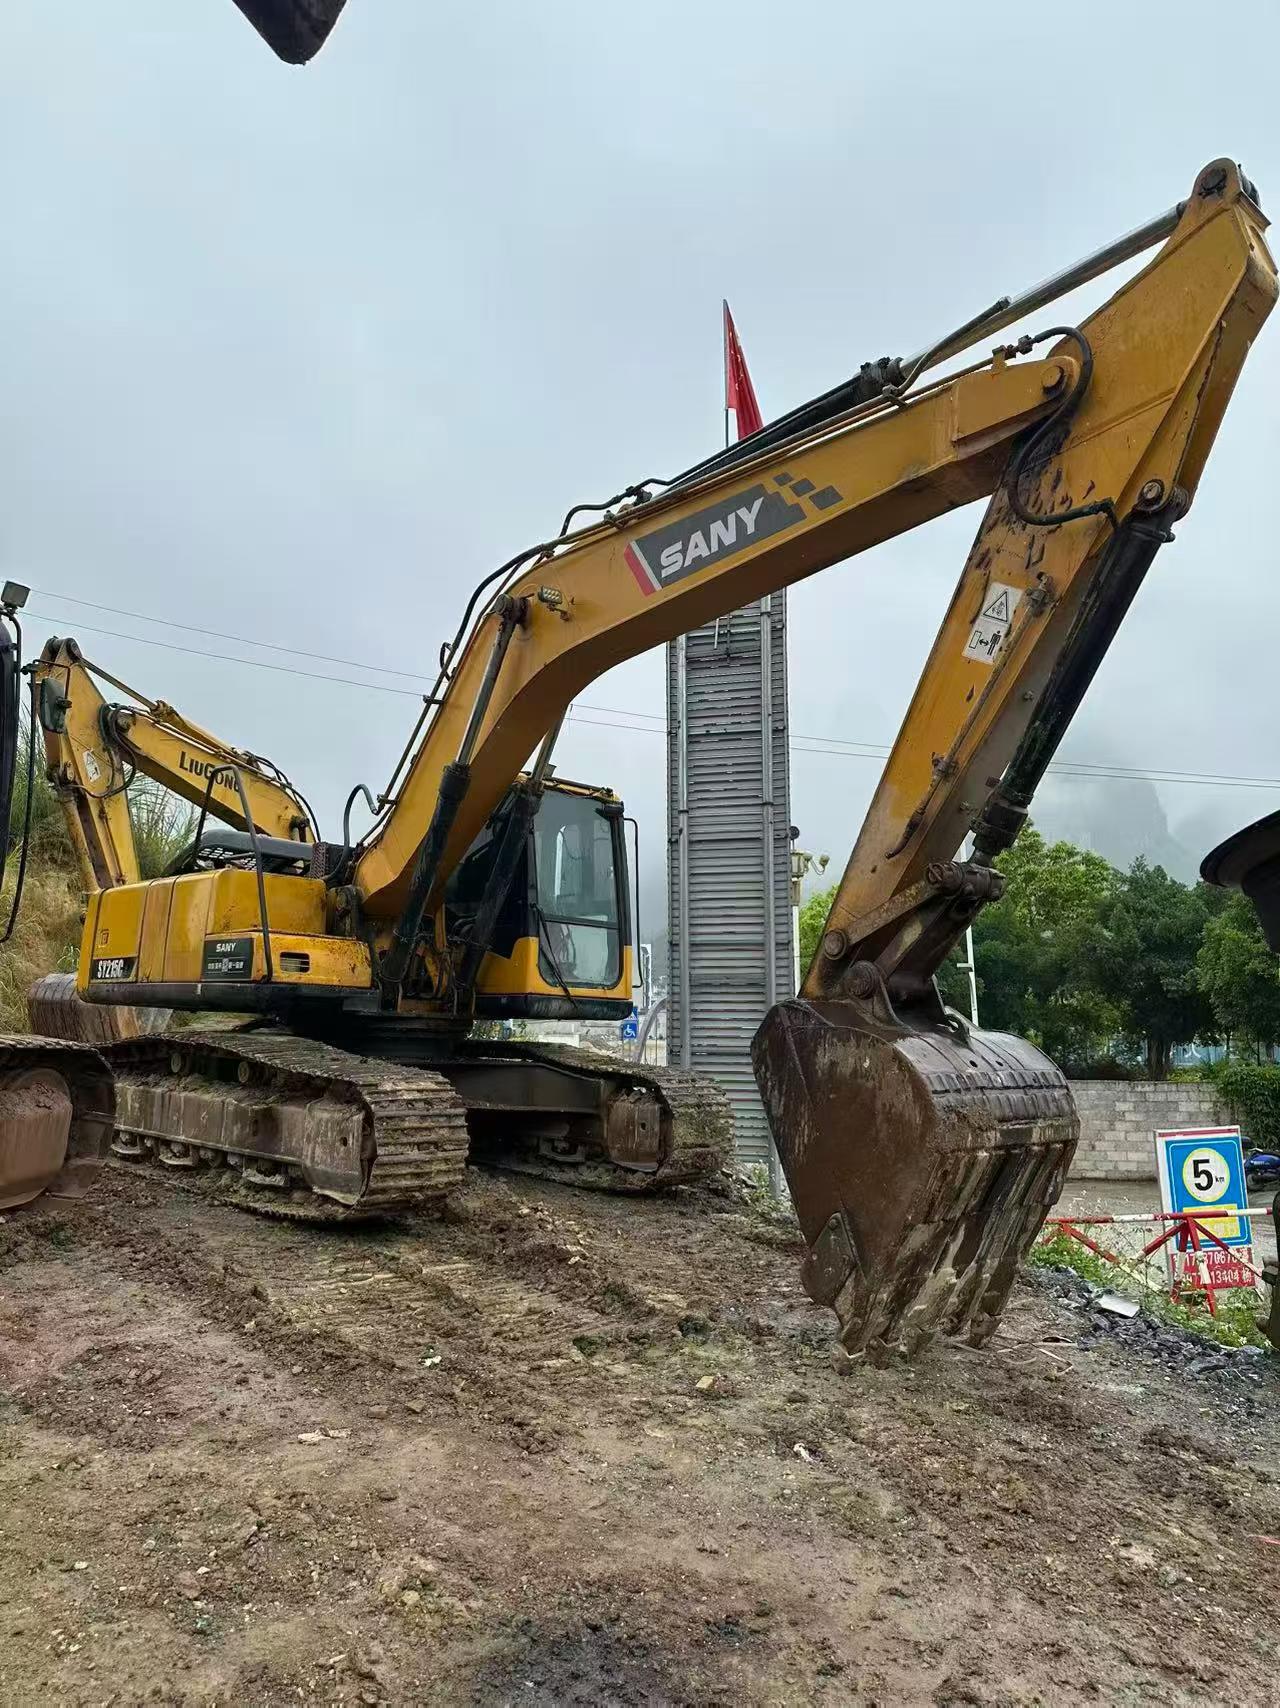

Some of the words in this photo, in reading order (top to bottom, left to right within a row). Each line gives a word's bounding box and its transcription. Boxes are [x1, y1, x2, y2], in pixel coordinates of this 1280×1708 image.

[660, 496, 765, 578] SANY
[215, 942, 237, 953] SANY
[97, 958, 125, 979] SY215C
[1192, 1158, 1214, 1192] 5
